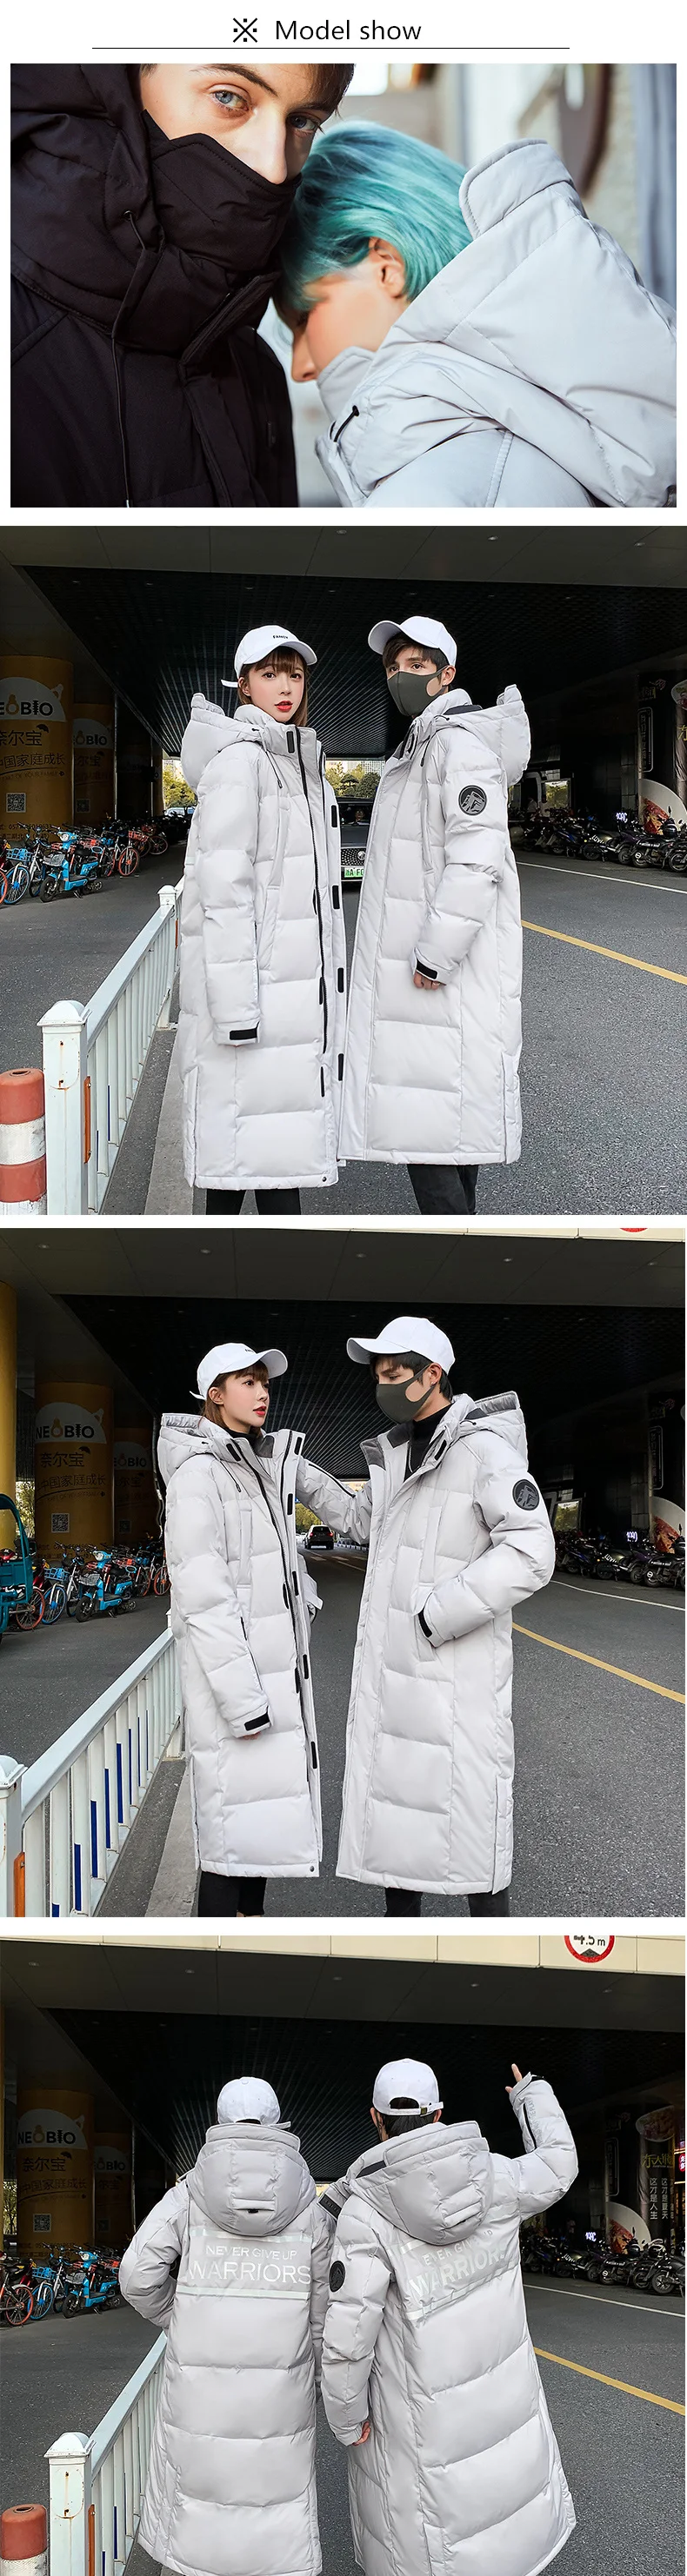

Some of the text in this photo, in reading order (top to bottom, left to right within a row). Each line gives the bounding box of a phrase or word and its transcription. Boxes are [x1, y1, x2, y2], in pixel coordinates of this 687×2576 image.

[73, 731, 107, 746] OBIO
[36, 1417, 95, 1439] NEOBIO
[40, 1451, 85, 1468] 奈尔宝
[37, 1474, 106, 1490] 中国家庭成长
[17, 2125, 76, 2145] NEOBIO
[22, 2156, 66, 2172] 奈尔宝
[94, 2157, 126, 2171] OBIO
[20, 2177, 88, 2194] 中国家庭成长
[205, 2245, 297, 2261] NEVER GIVE UP
[189, 2261, 311, 2285] WARRIORS
